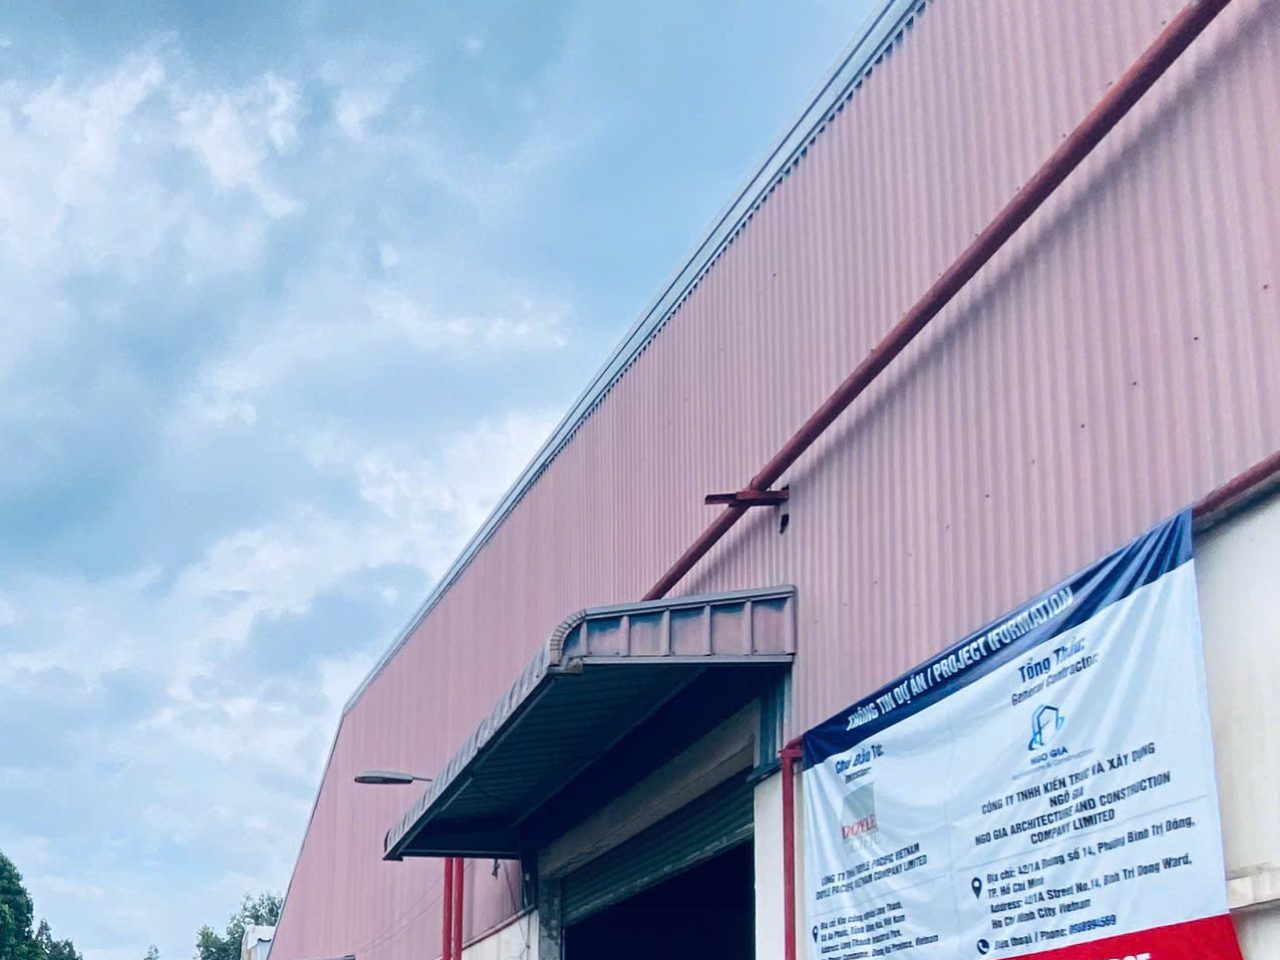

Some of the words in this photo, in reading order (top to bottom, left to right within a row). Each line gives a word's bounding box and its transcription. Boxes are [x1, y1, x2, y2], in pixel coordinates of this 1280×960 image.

[876, 692, 896, 714] TIN
[893, 680, 911, 704] DỰ
[910, 673, 928, 696] ÁN
[927, 667, 933, 687] /
[932, 636, 987, 682] PROJECT
[1018, 657, 1051, 683] Tổng
[993, 827, 1008, 840] GIA
[1074, 798, 1096, 813] AND
[1099, 770, 1171, 806] CONSTRUCTION
[1016, 785, 1041, 802] TNHH
[1073, 808, 1115, 830] LIMITED
